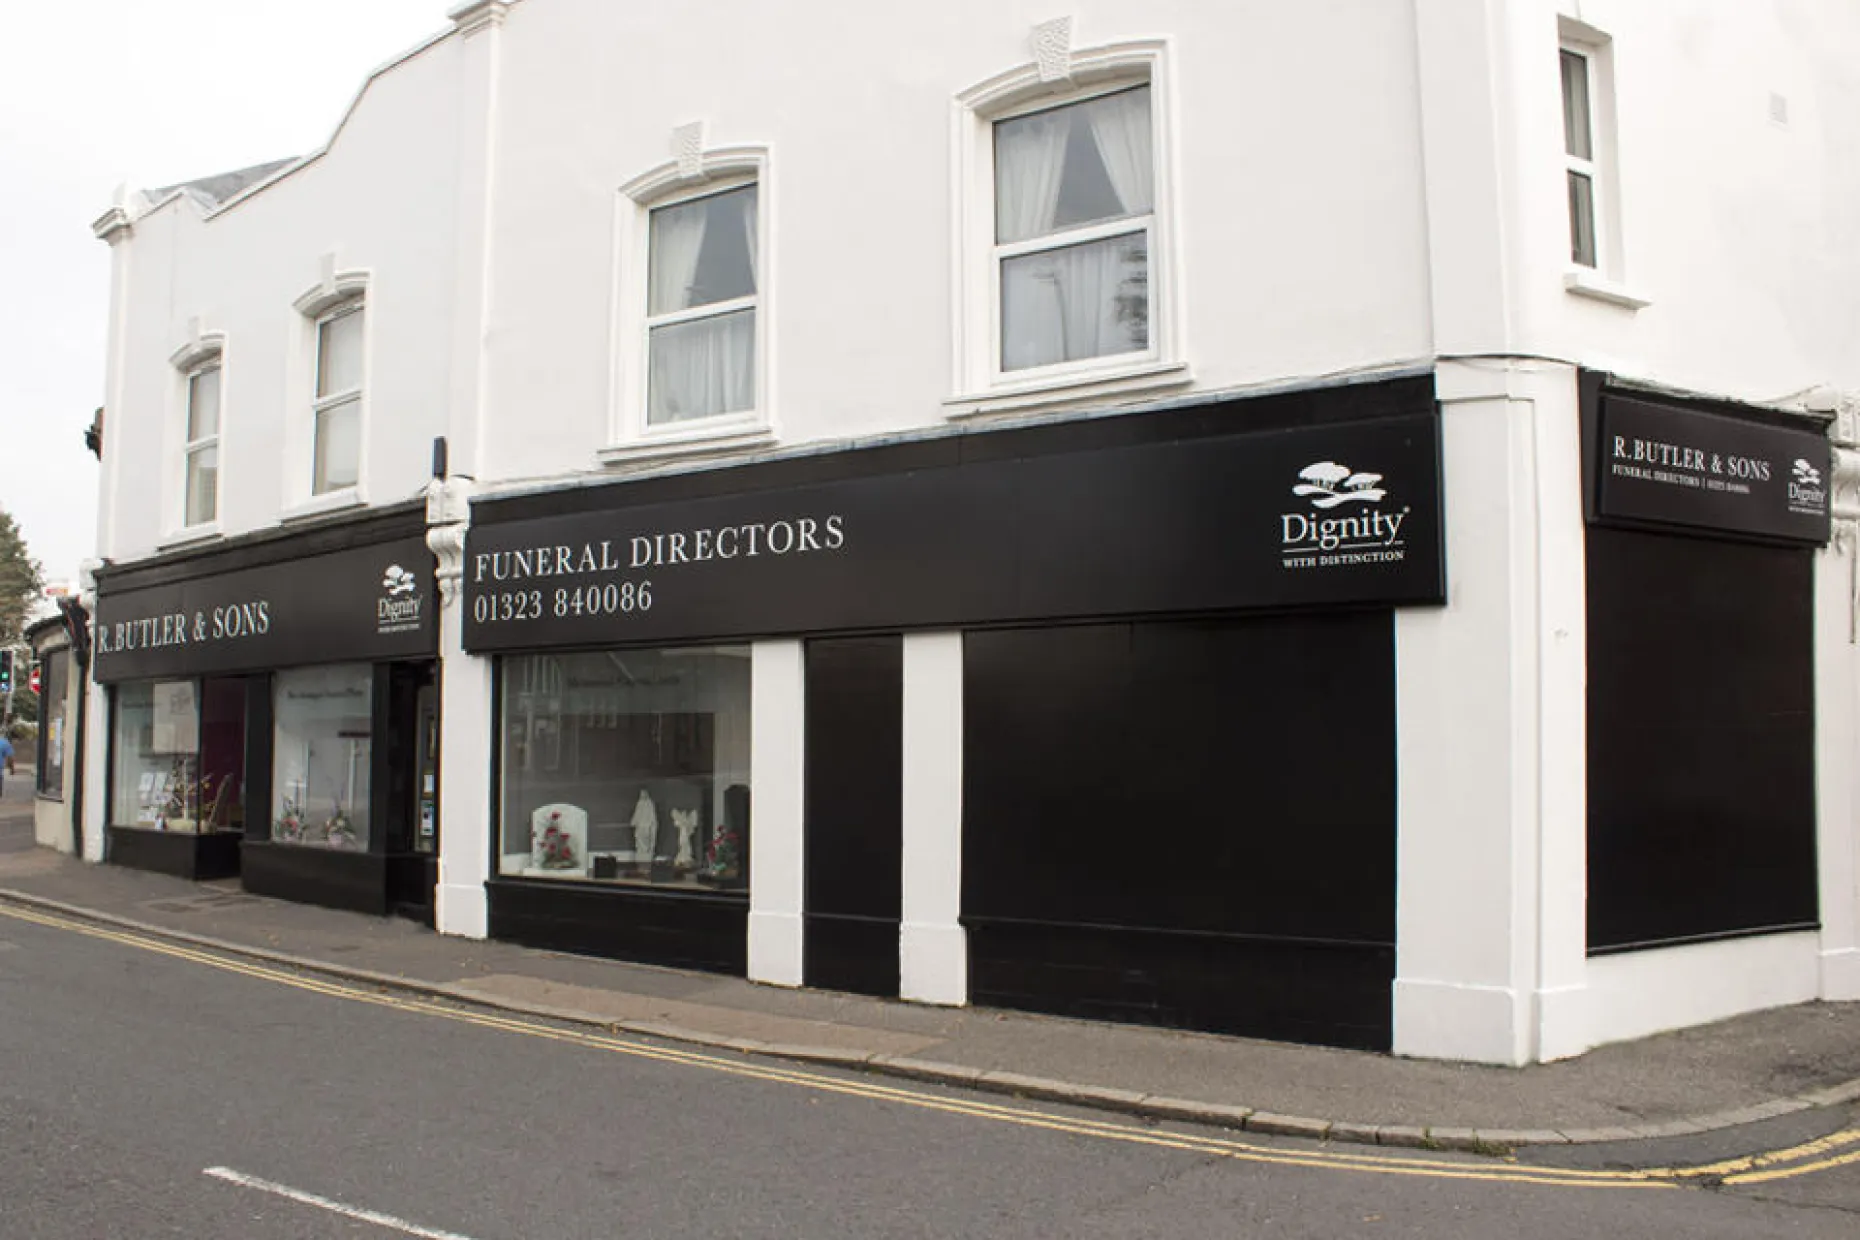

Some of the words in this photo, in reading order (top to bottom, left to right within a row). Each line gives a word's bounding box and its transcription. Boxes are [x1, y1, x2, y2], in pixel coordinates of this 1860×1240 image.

[1711, 453, 1723, 474] &
[1727, 455, 1771, 482] SONS
[473, 540, 619, 583] FUNERAL
[629, 514, 845, 568] DIRECTORS
[1280, 507, 1405, 550] Dignity
[1282, 557, 1316, 568] WITH
[1320, 549, 1405, 567] DISTINCTION
[193, 611, 206, 642] &
[212, 600, 270, 640] SONS
[378, 596, 421, 623] Dignity
[473, 590, 542, 623] 01323
[553, 580, 653, 618] 840086
